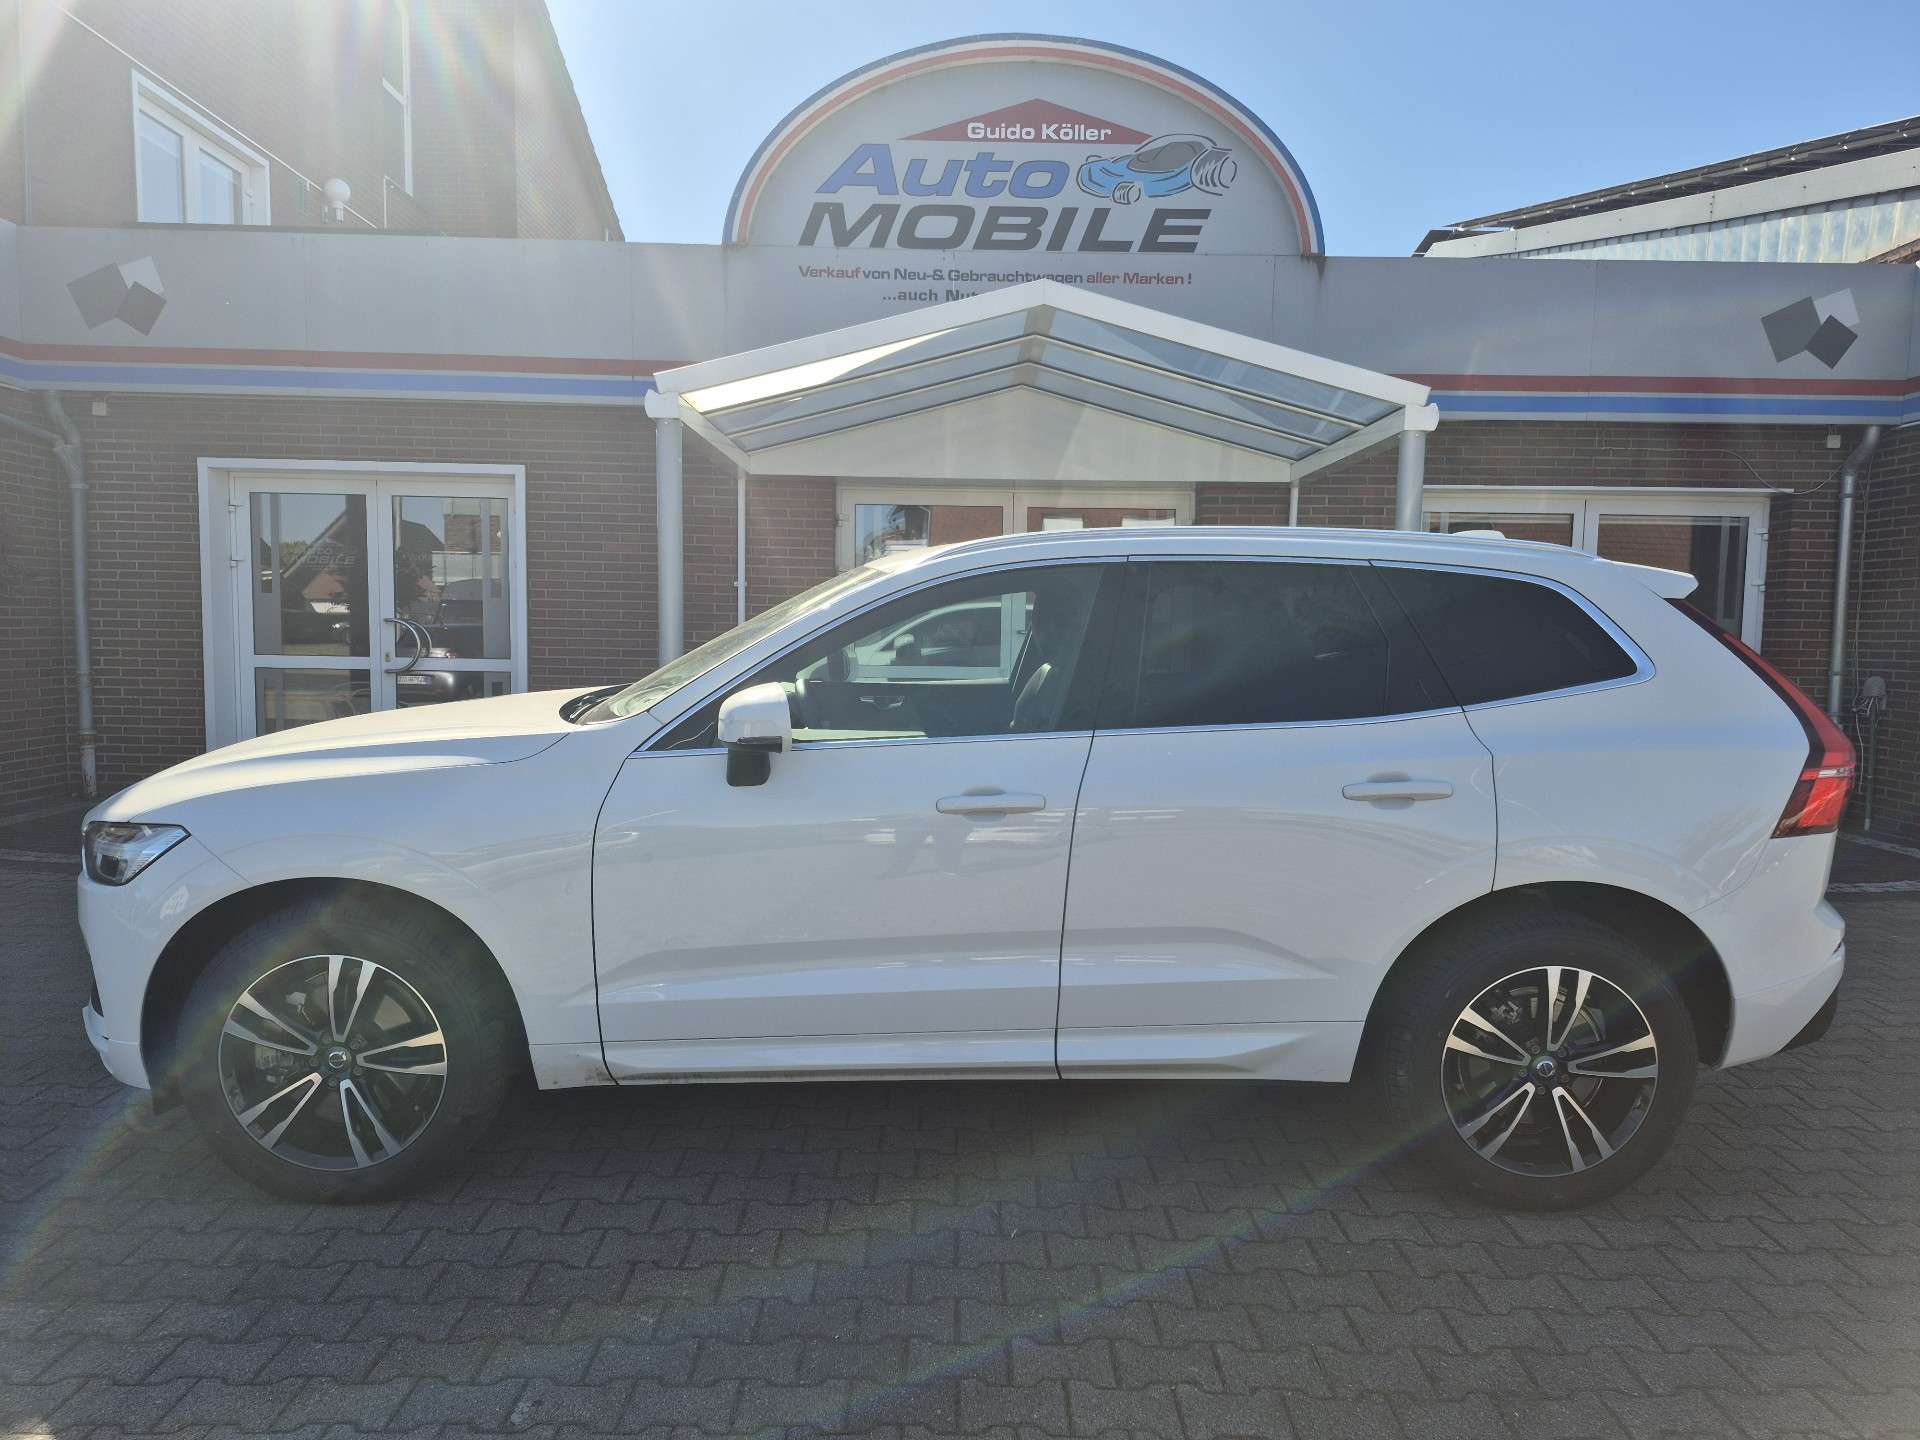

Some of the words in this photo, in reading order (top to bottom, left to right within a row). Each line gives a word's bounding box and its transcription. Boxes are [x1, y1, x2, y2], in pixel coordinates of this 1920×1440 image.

[967, 122, 1035, 140] Guido
[1041, 122, 1112, 141] Köller
[815, 143, 1070, 199] Auto
[798, 201, 1213, 253] MOBILE
[798, 265, 862, 279] Verkauf
[863, 269, 891, 280] von
[1086, 271, 1121, 284] aller
[1122, 272, 1184, 285] Marken
